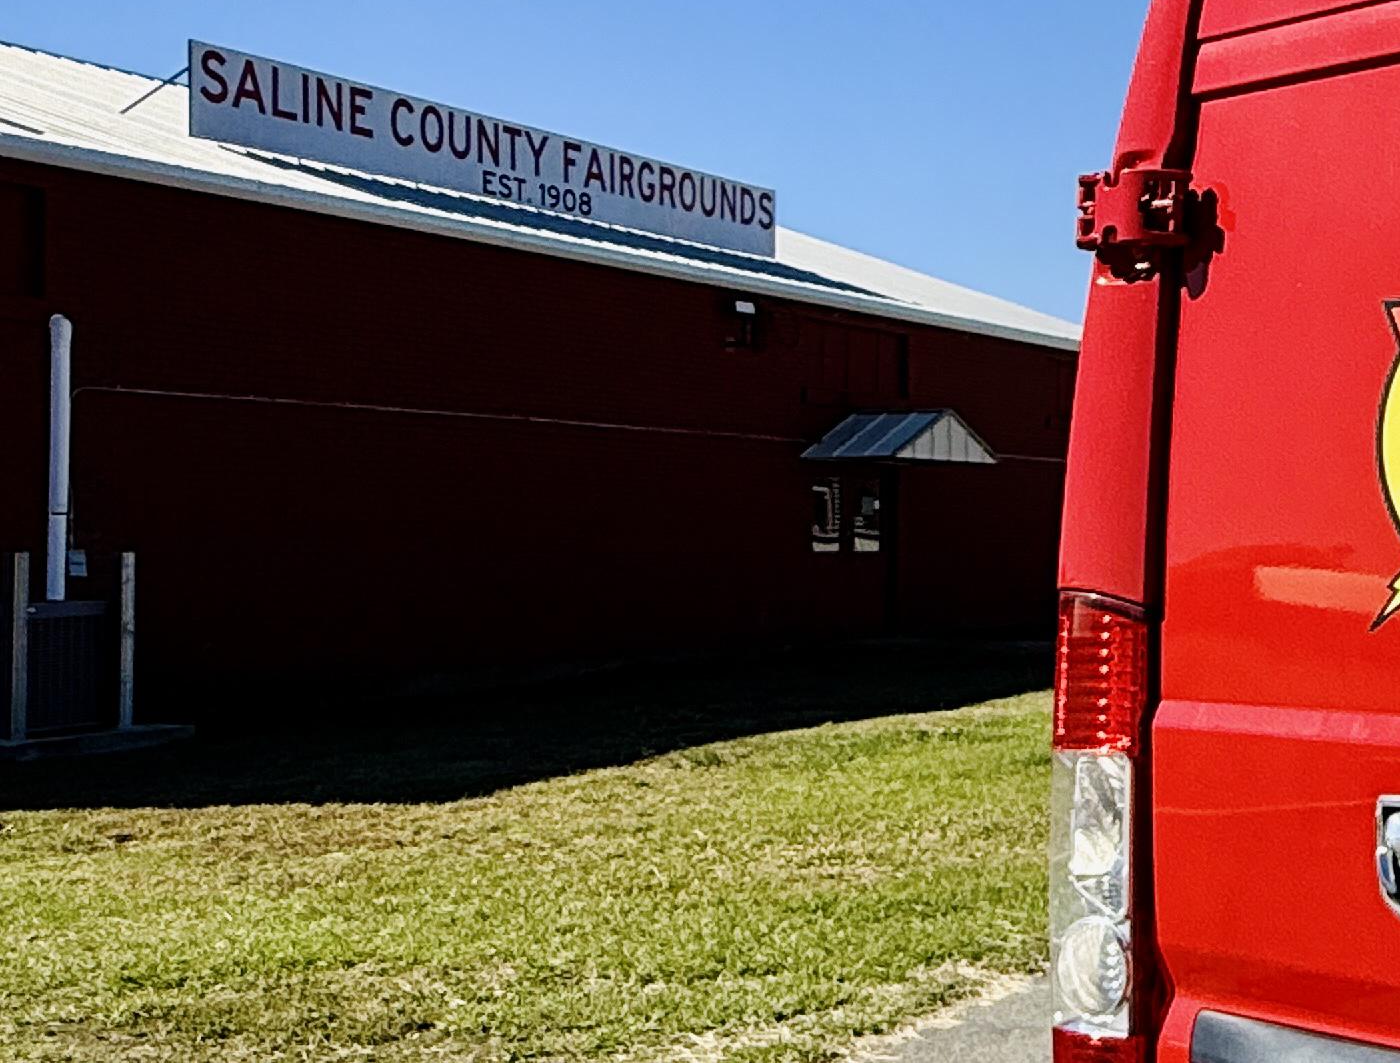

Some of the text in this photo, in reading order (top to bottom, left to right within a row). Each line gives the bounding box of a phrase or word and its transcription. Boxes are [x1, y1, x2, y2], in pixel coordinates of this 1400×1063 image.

[199, 49, 775, 231] SALINE COUNTY FAIRGROUNDS
[482, 170, 593, 216] EST. 1908
